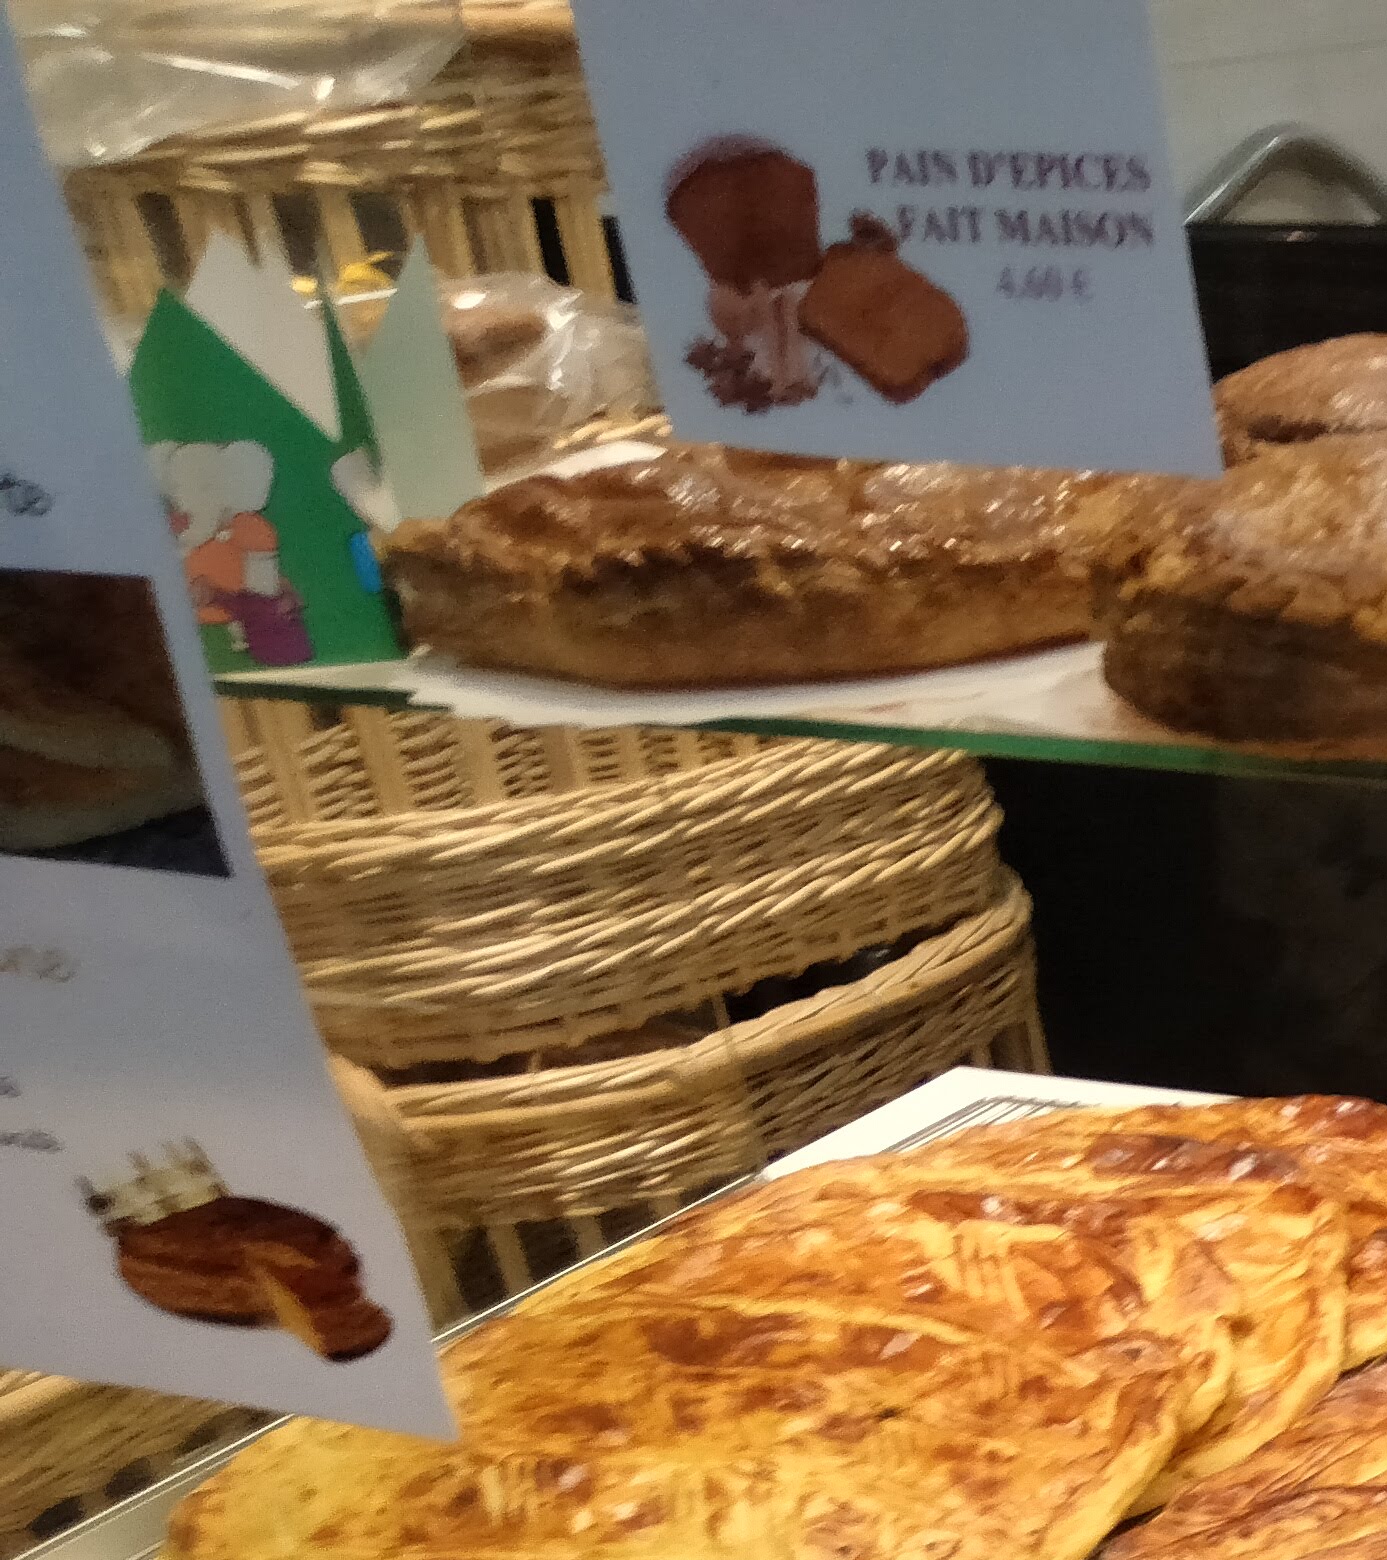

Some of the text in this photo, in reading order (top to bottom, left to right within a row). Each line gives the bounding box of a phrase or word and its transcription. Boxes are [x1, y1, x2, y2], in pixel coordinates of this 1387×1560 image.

[865, 146, 958, 189] PAIN
[896, 203, 1155, 249] FAIT MAISON
